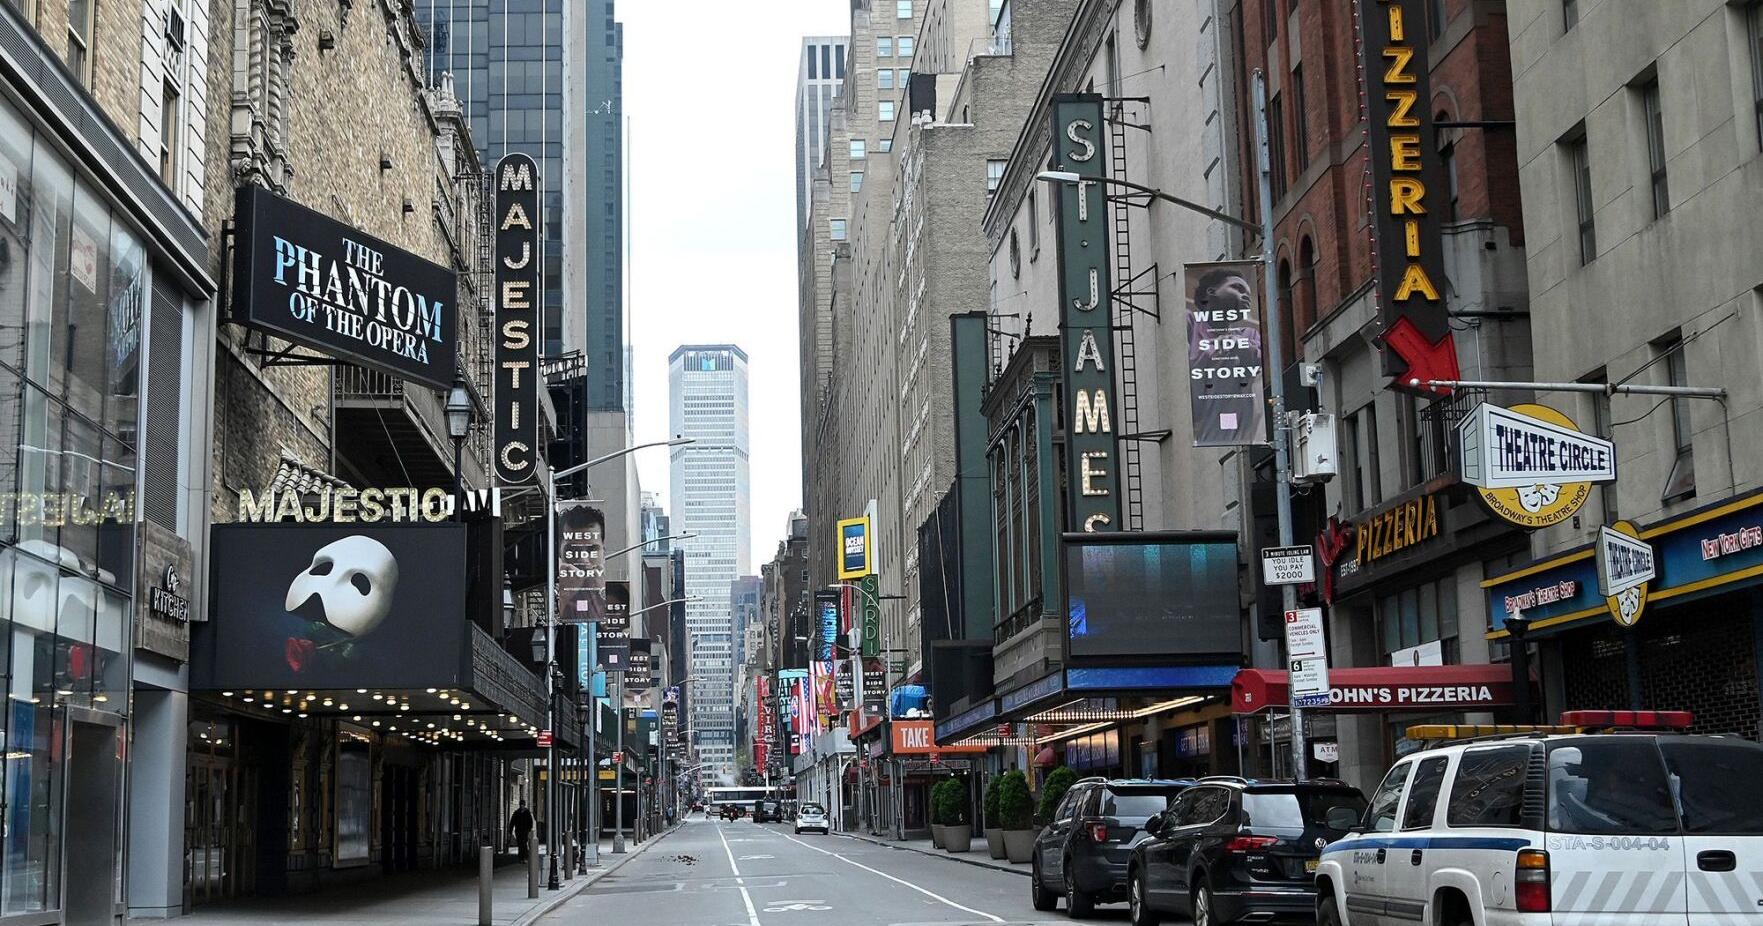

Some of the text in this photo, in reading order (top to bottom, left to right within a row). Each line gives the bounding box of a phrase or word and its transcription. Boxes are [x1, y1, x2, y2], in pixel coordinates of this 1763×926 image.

[1377, 0, 1440, 300] IZZERIA
[342, 238, 384, 277] THE
[273, 235, 444, 343] PHANTOM
[500, 163, 533, 471] MAJESTIC
[1194, 309, 1251, 322] WEST
[289, 292, 430, 365] OF THE OPERA
[1198, 338, 1250, 351] SIDE
[1191, 366, 1260, 380] STORY
[1496, 424, 1606, 471] THEATRE CIRCLE
[1485, 484, 1588, 525] BROADWAY'S THEATRE SHOP
[563, 532, 600, 540] WEST
[1356, 495, 1438, 567] PIZZERIA
[1701, 526, 1763, 560] NEW YORK GIFTS
[565, 551, 598, 559] SIDE
[560, 569, 605, 578] STORY
[1276, 571, 1303, 579] $2000
[153, 587, 190, 623] KITCHEN
[1289, 612, 1295, 622] 3
[1293, 661, 1300, 671] 6
[1326, 686, 1493, 703] OHN'S PIZZERIA
[900, 728, 930, 748] TAKE
[1548, 835, 1671, 851] STA-S-004-04
